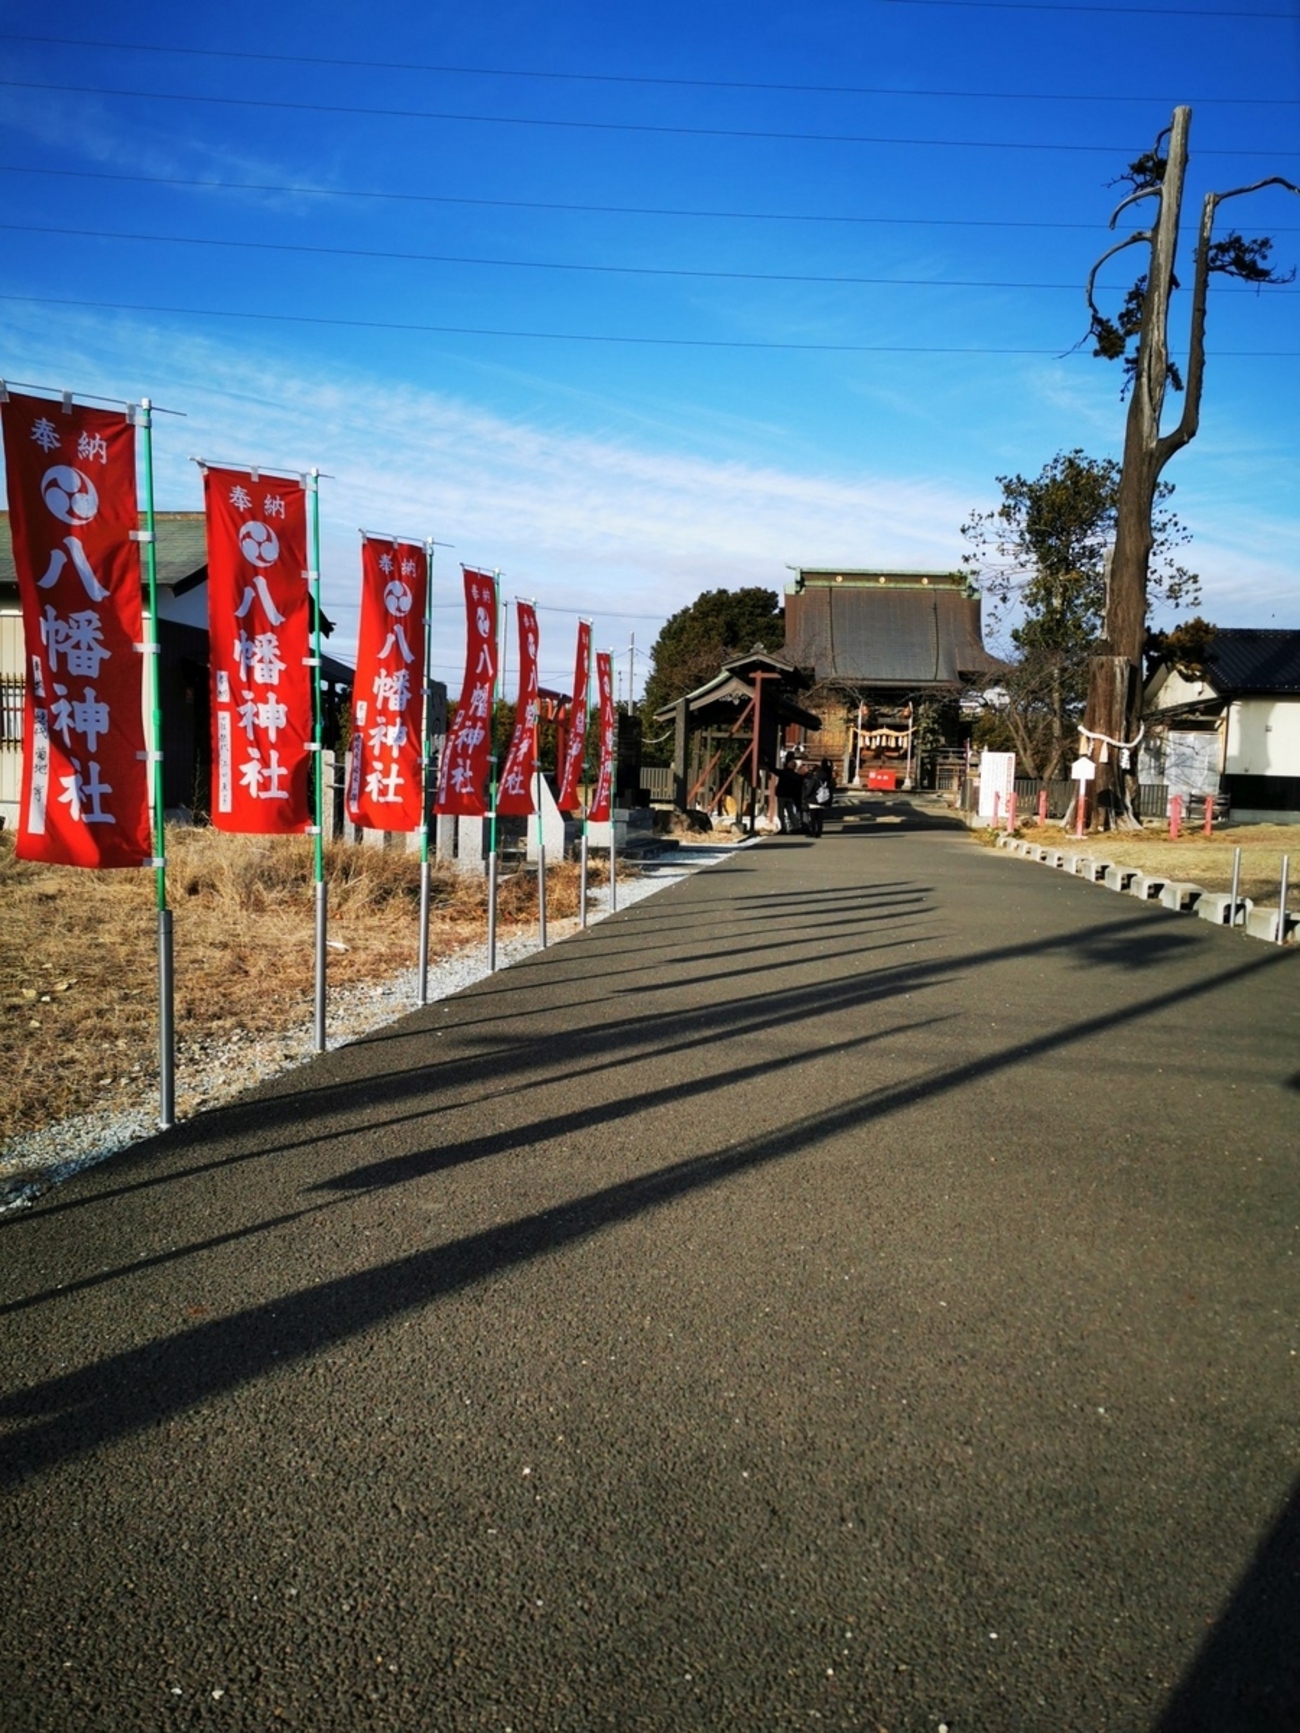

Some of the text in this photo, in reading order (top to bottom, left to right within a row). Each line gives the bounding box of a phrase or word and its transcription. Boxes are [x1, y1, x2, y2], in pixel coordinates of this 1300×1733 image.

[30, 416, 108, 465] 奉納
[229, 485, 286, 520] 奉納
[378, 553, 416, 578] 奉納
[36, 535, 117, 825] 八幡神社
[233, 575, 290, 801] 八幡神社
[365, 623, 415, 803] 八幡神社
[451, 643, 493, 794] 八幡神社
